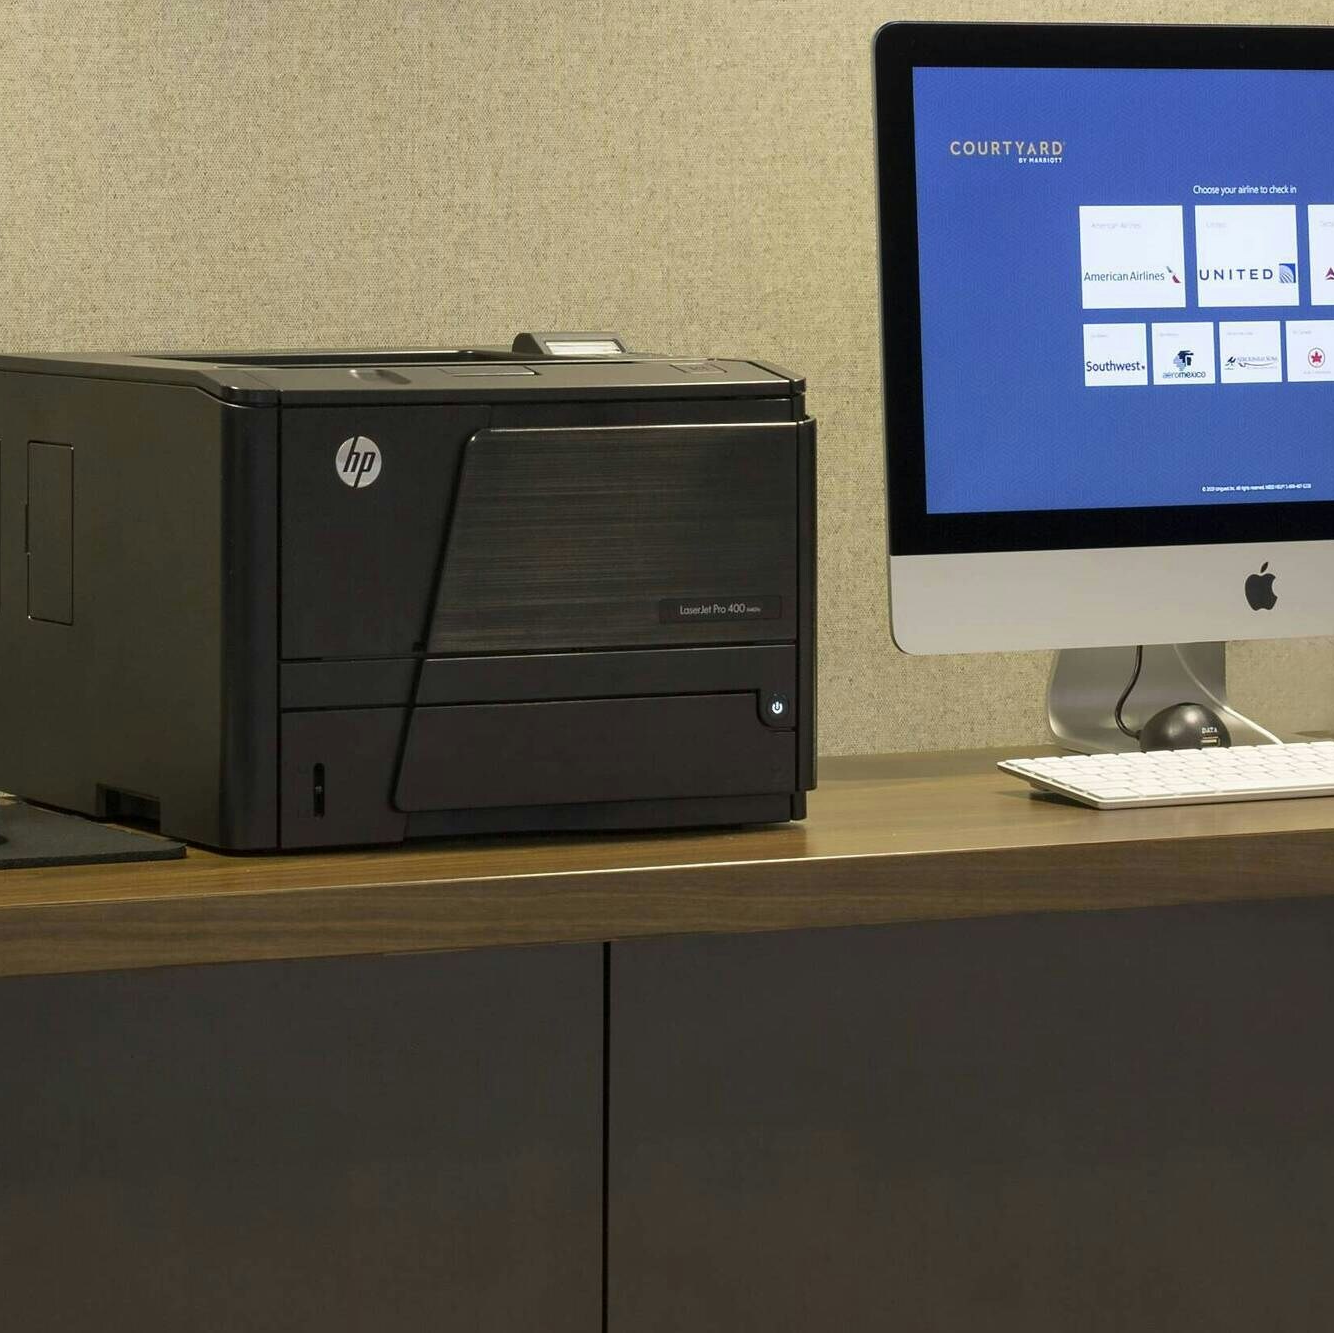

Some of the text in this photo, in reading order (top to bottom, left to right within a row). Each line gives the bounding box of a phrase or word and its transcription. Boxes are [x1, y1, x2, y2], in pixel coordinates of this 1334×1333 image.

[949, 141, 1063, 156] COURTYARD
[1193, 184, 1297, 196] Choose your airline to check in
[1083, 270, 1165, 282] American Airlines
[1199, 269, 1274, 281] UNITED
[1086, 359, 1141, 372] Southwest
[342, 435, 377, 488] hp
[680, 604, 712, 615] LaserJet
[713, 603, 727, 614] Pro
[728, 603, 746, 614] 400
